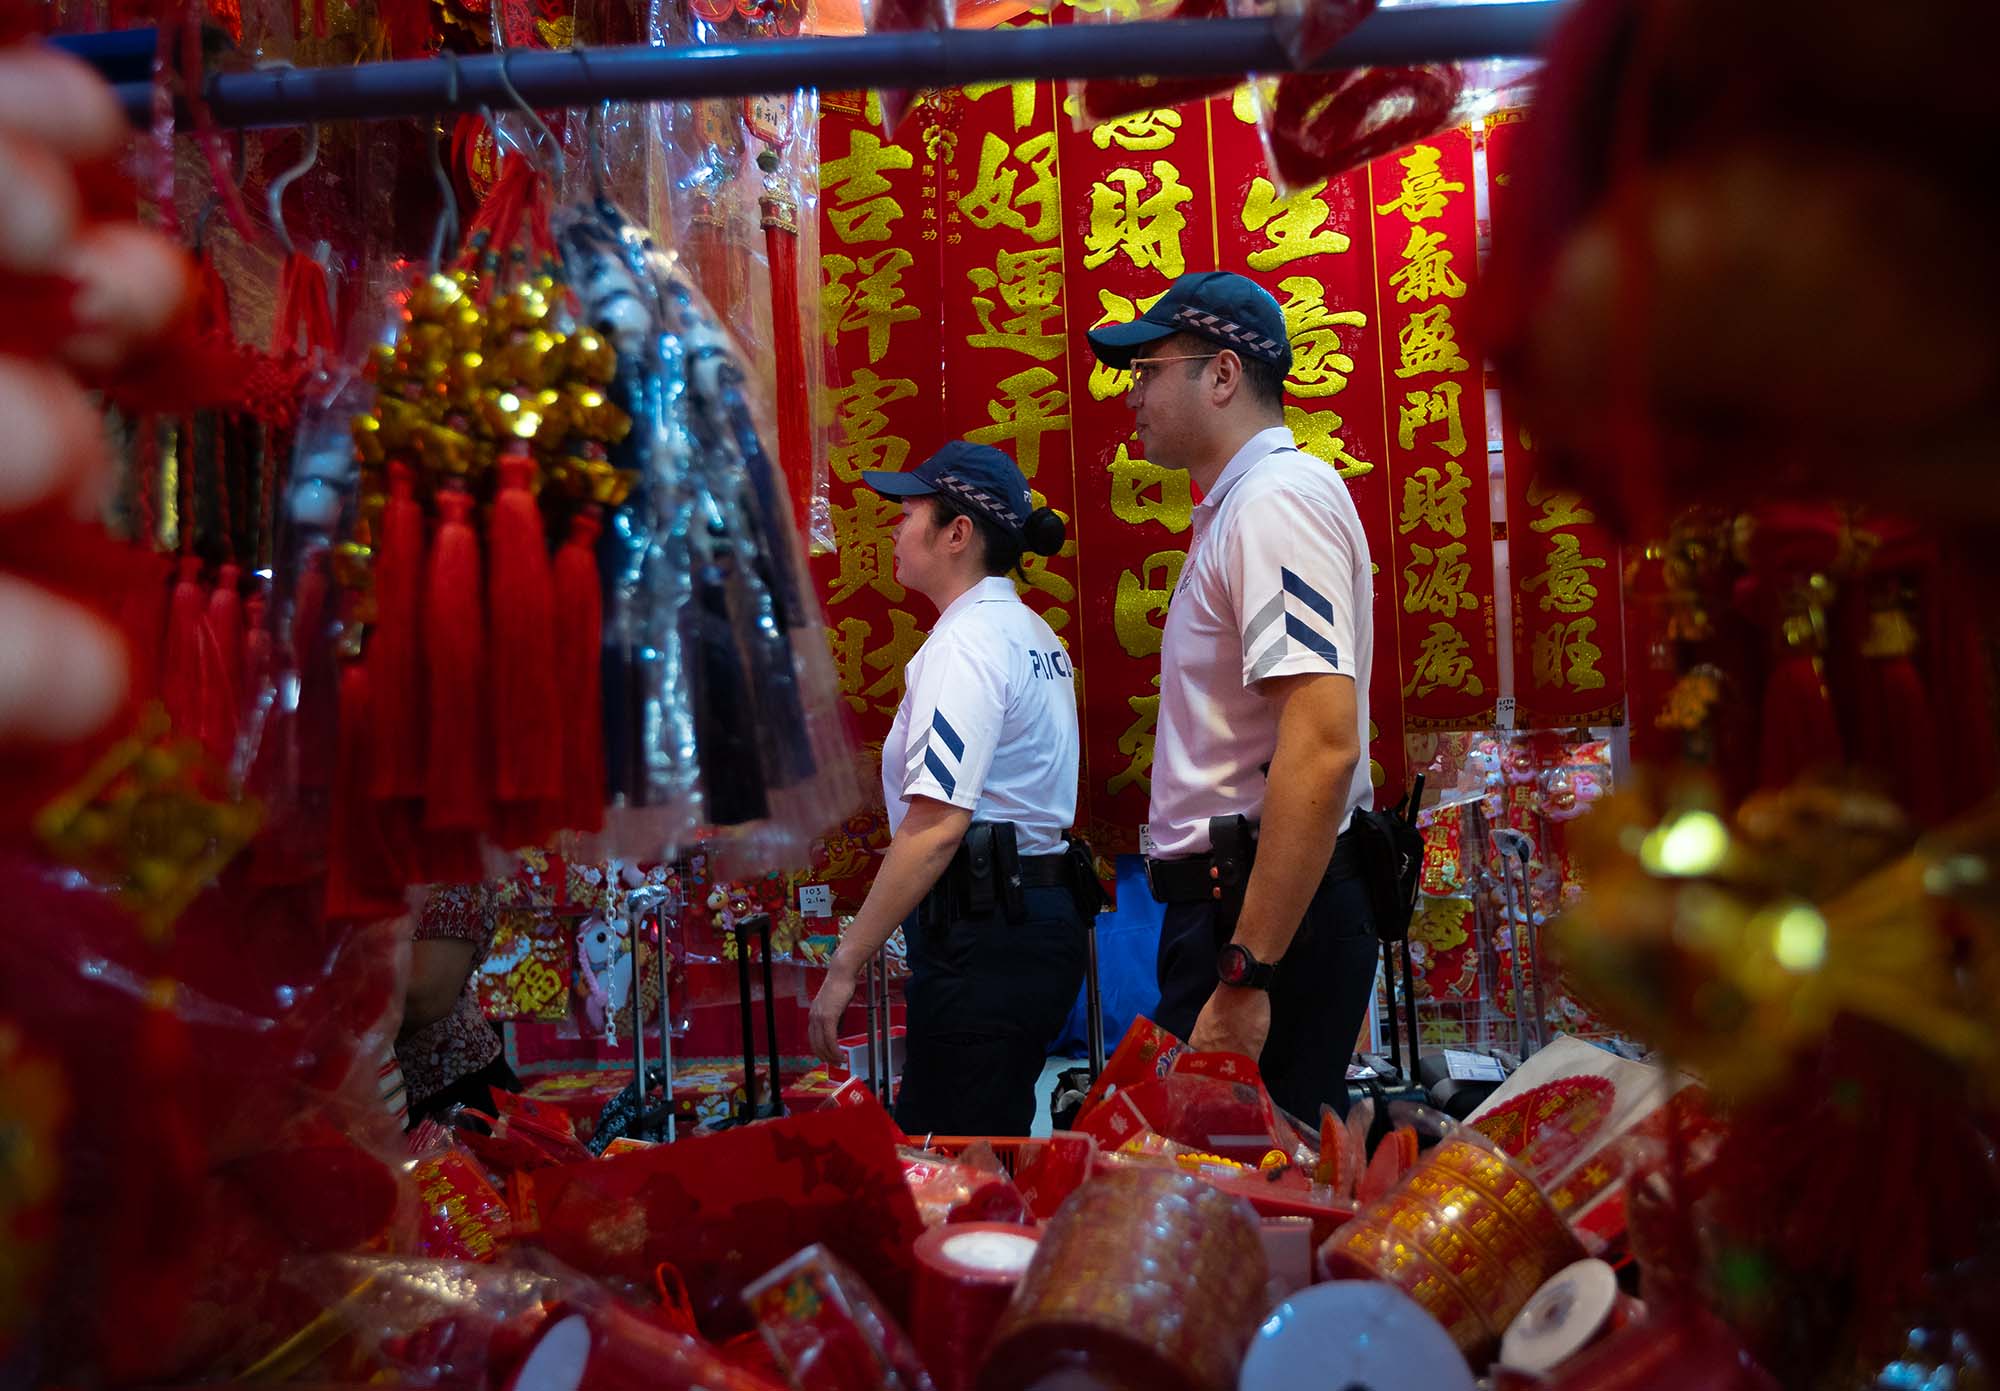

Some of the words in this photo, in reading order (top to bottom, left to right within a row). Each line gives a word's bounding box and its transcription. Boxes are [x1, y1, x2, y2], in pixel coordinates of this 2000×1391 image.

[820, 88, 930, 718] 吉祥富貴財
[1519, 432, 1606, 692] 生意旺
[805, 887, 822, 896] 103
